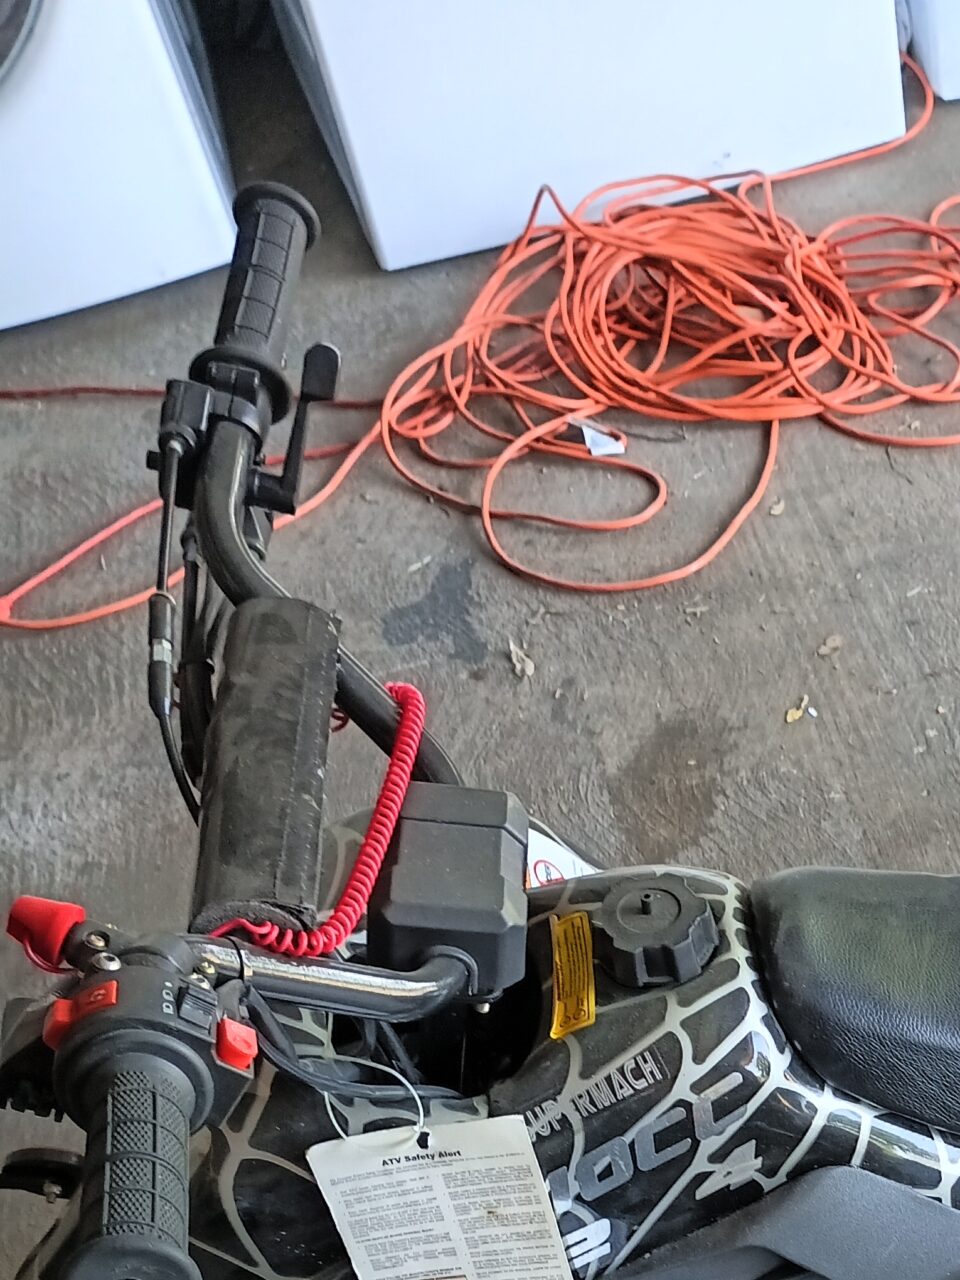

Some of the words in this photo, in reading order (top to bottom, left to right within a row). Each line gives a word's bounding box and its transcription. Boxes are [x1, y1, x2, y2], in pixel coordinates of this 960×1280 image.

[382, 1157, 401, 1167] ATV
[404, 1152, 435, 1162] Safety
[438, 1150, 461, 1158] Alert
